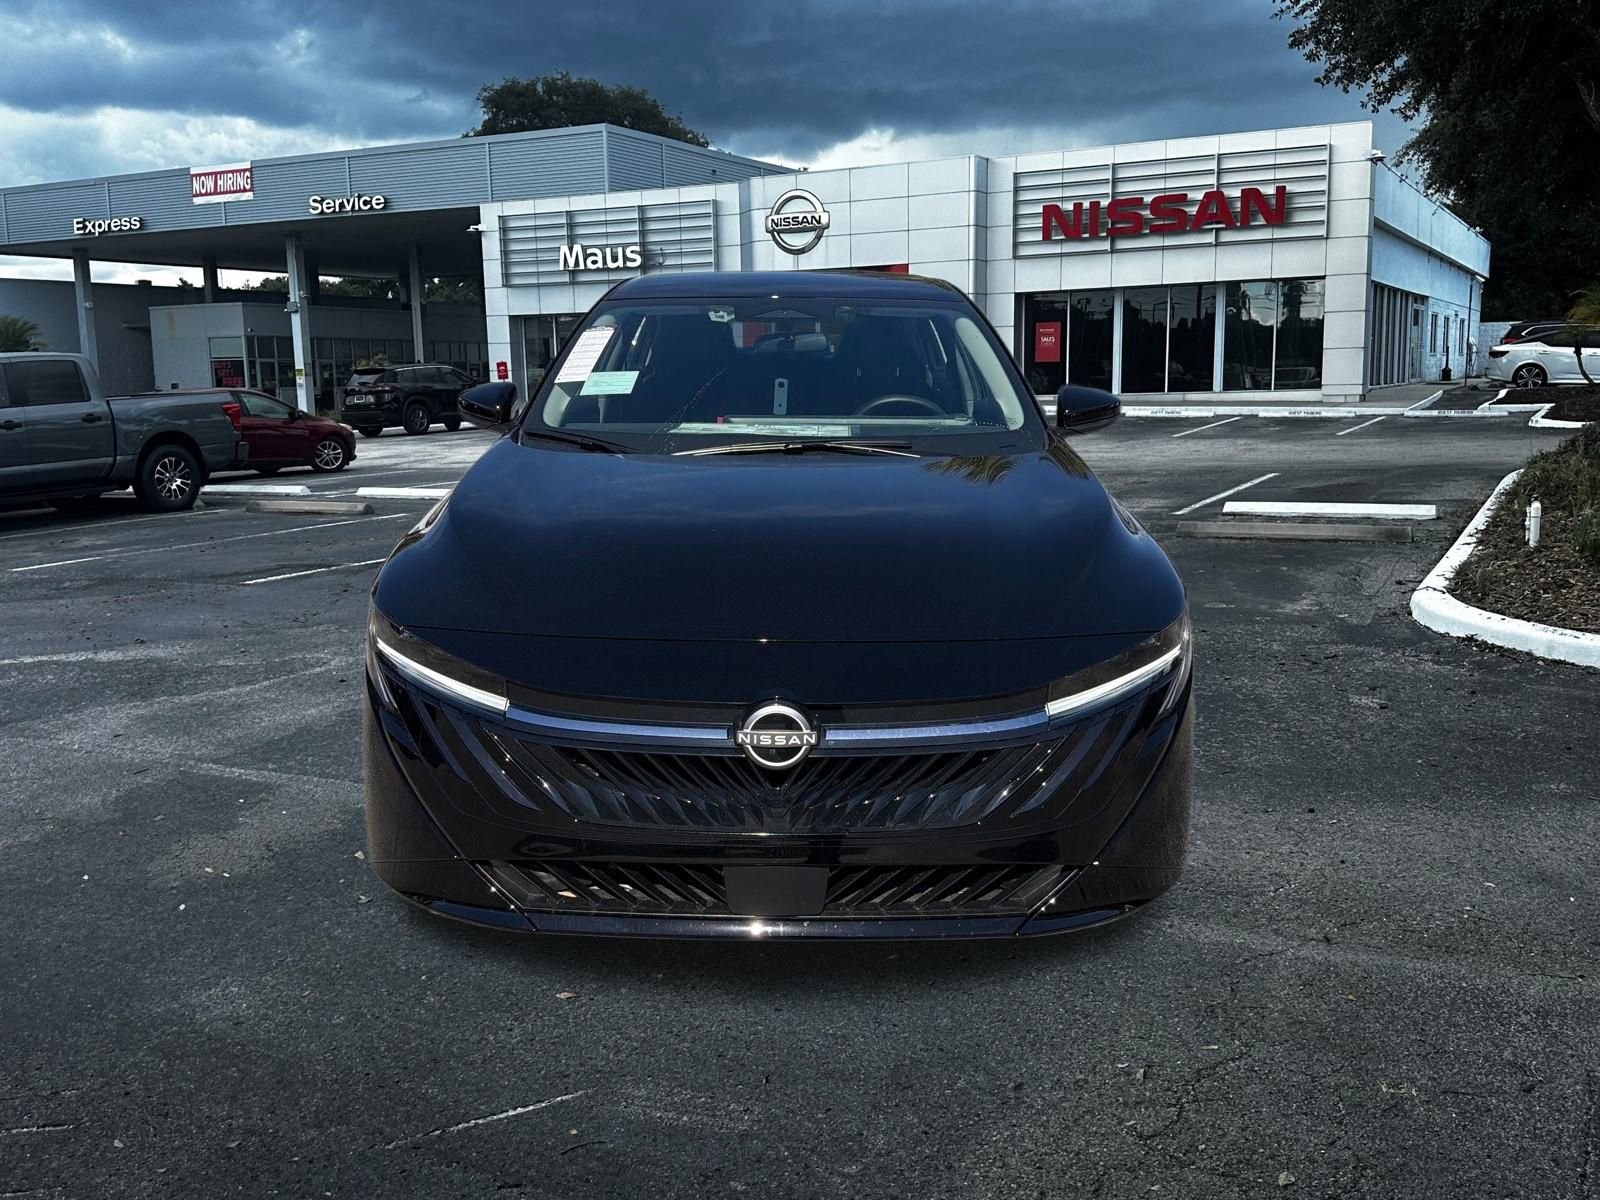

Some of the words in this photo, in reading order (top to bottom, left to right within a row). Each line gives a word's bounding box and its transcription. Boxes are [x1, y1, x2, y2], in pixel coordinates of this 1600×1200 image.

[193, 175, 215, 195] NOW
[217, 171, 251, 193] HIRING
[309, 193, 385, 214] Service
[1042, 185, 1287, 241] NISSAN
[73, 217, 141, 237] Express
[770, 215, 822, 228] NISSAN
[560, 244, 642, 271] Maus
[738, 733, 816, 745] NISSAN
